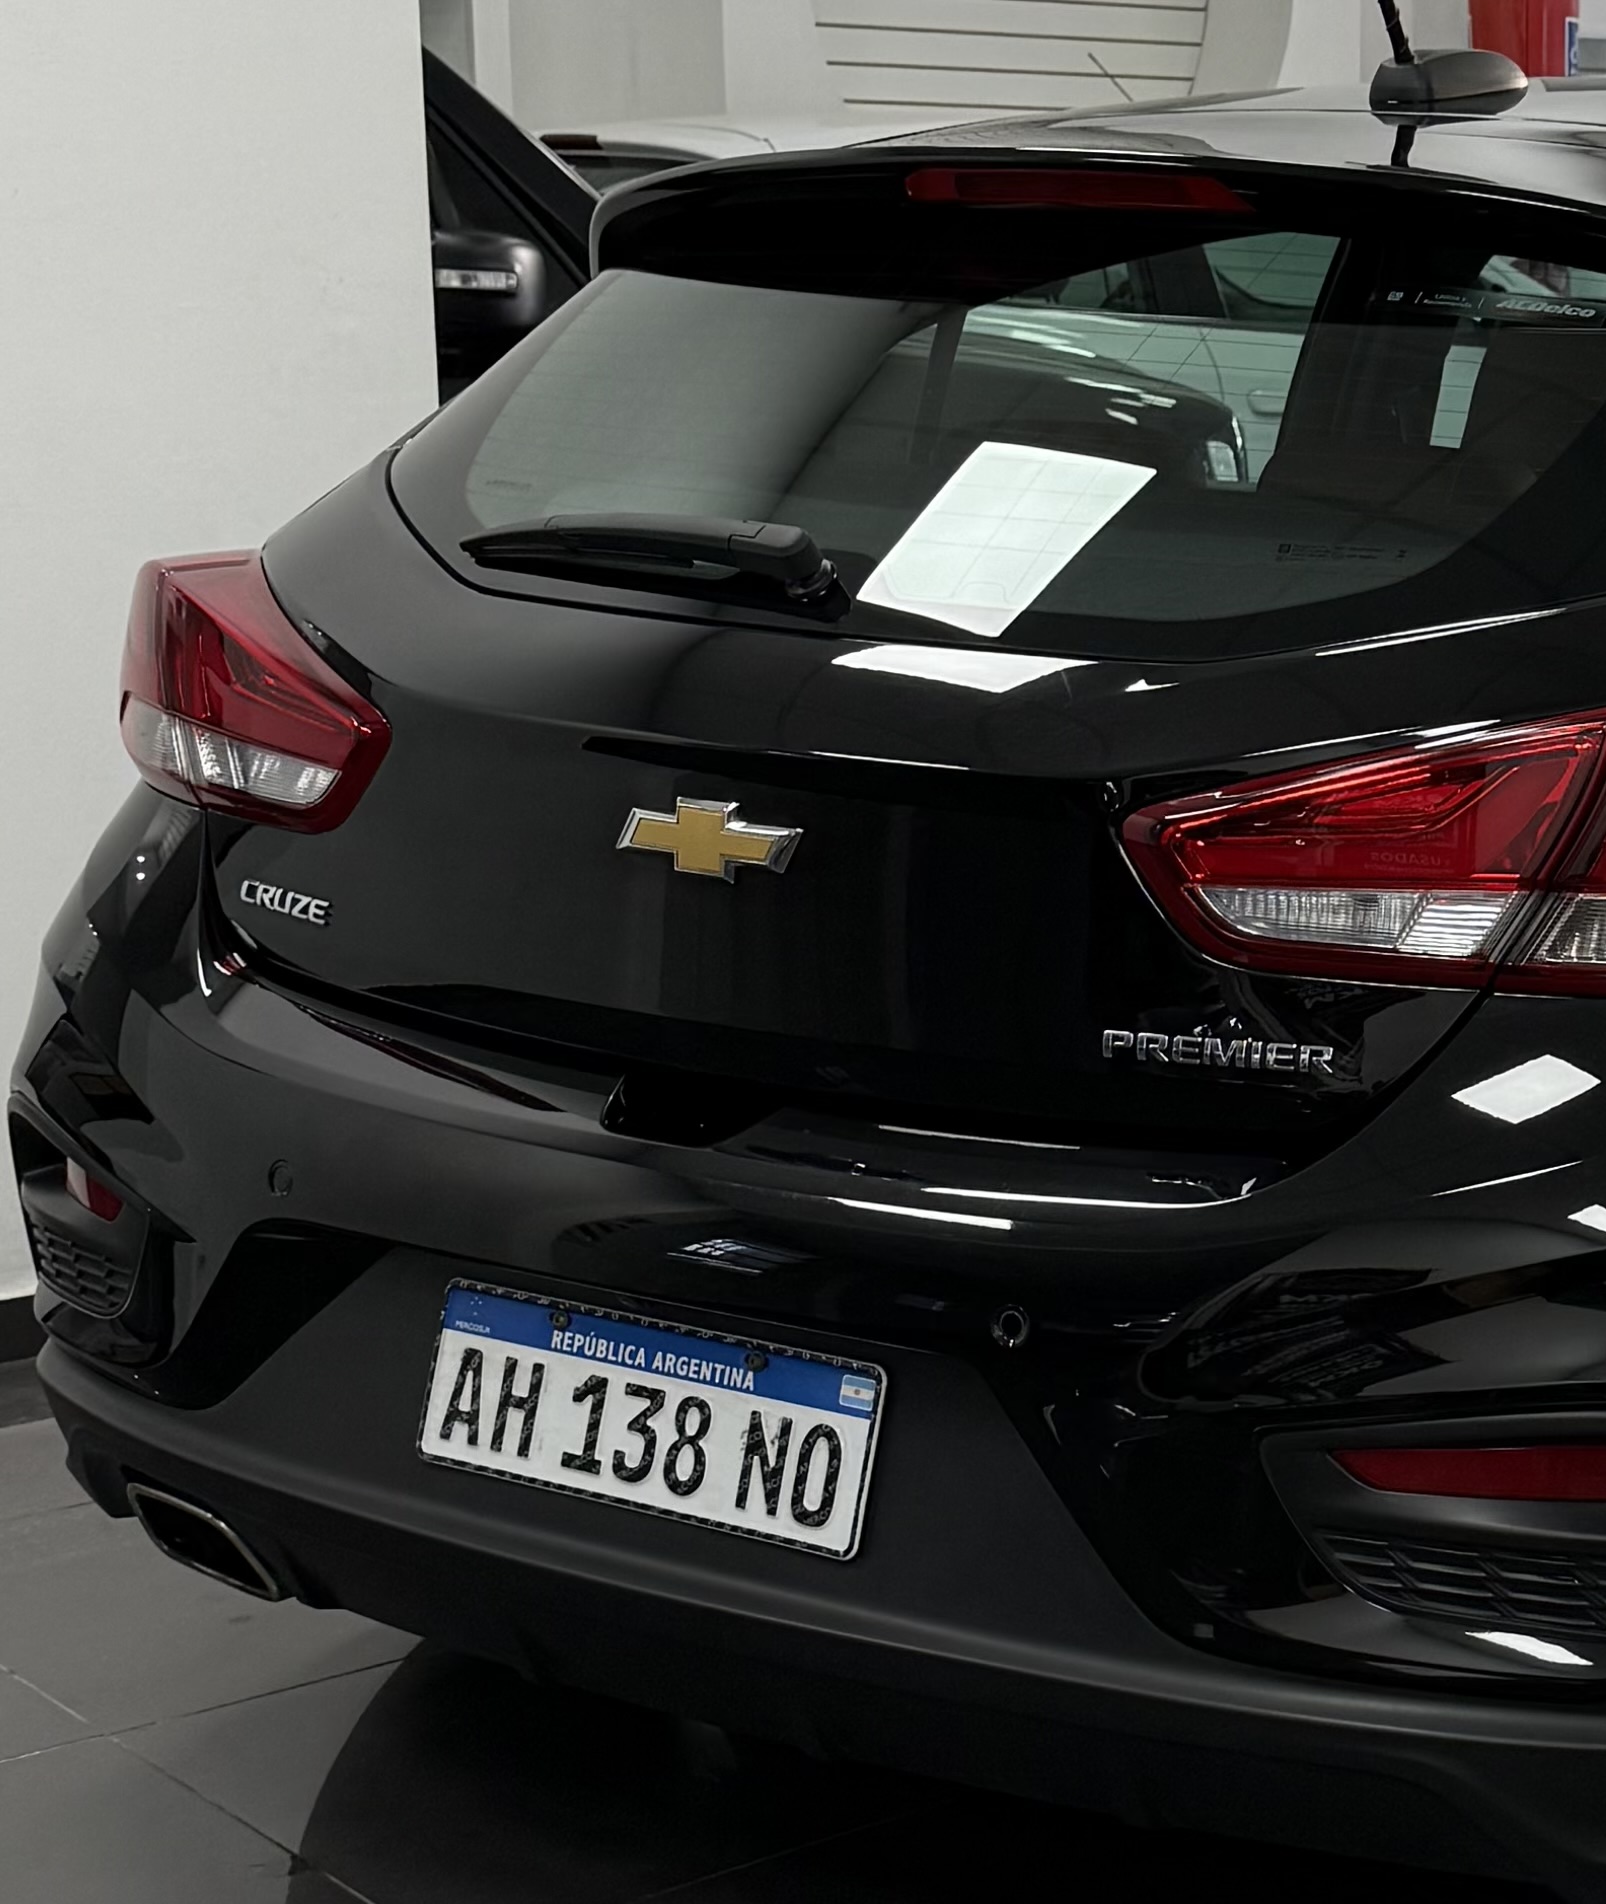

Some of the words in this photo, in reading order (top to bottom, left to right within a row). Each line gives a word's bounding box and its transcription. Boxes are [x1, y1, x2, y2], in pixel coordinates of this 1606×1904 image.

[240, 880, 330, 925] CRUZE
[1102, 1029, 1334, 1073] PREMIER
[552, 1330, 646, 1367] REPÚBLICA
[652, 1351, 754, 1391] ARGENTINA
[439, 1348, 545, 1458] AH
[561, 1374, 713, 1497] 138
[735, 1410, 842, 1528] NO
